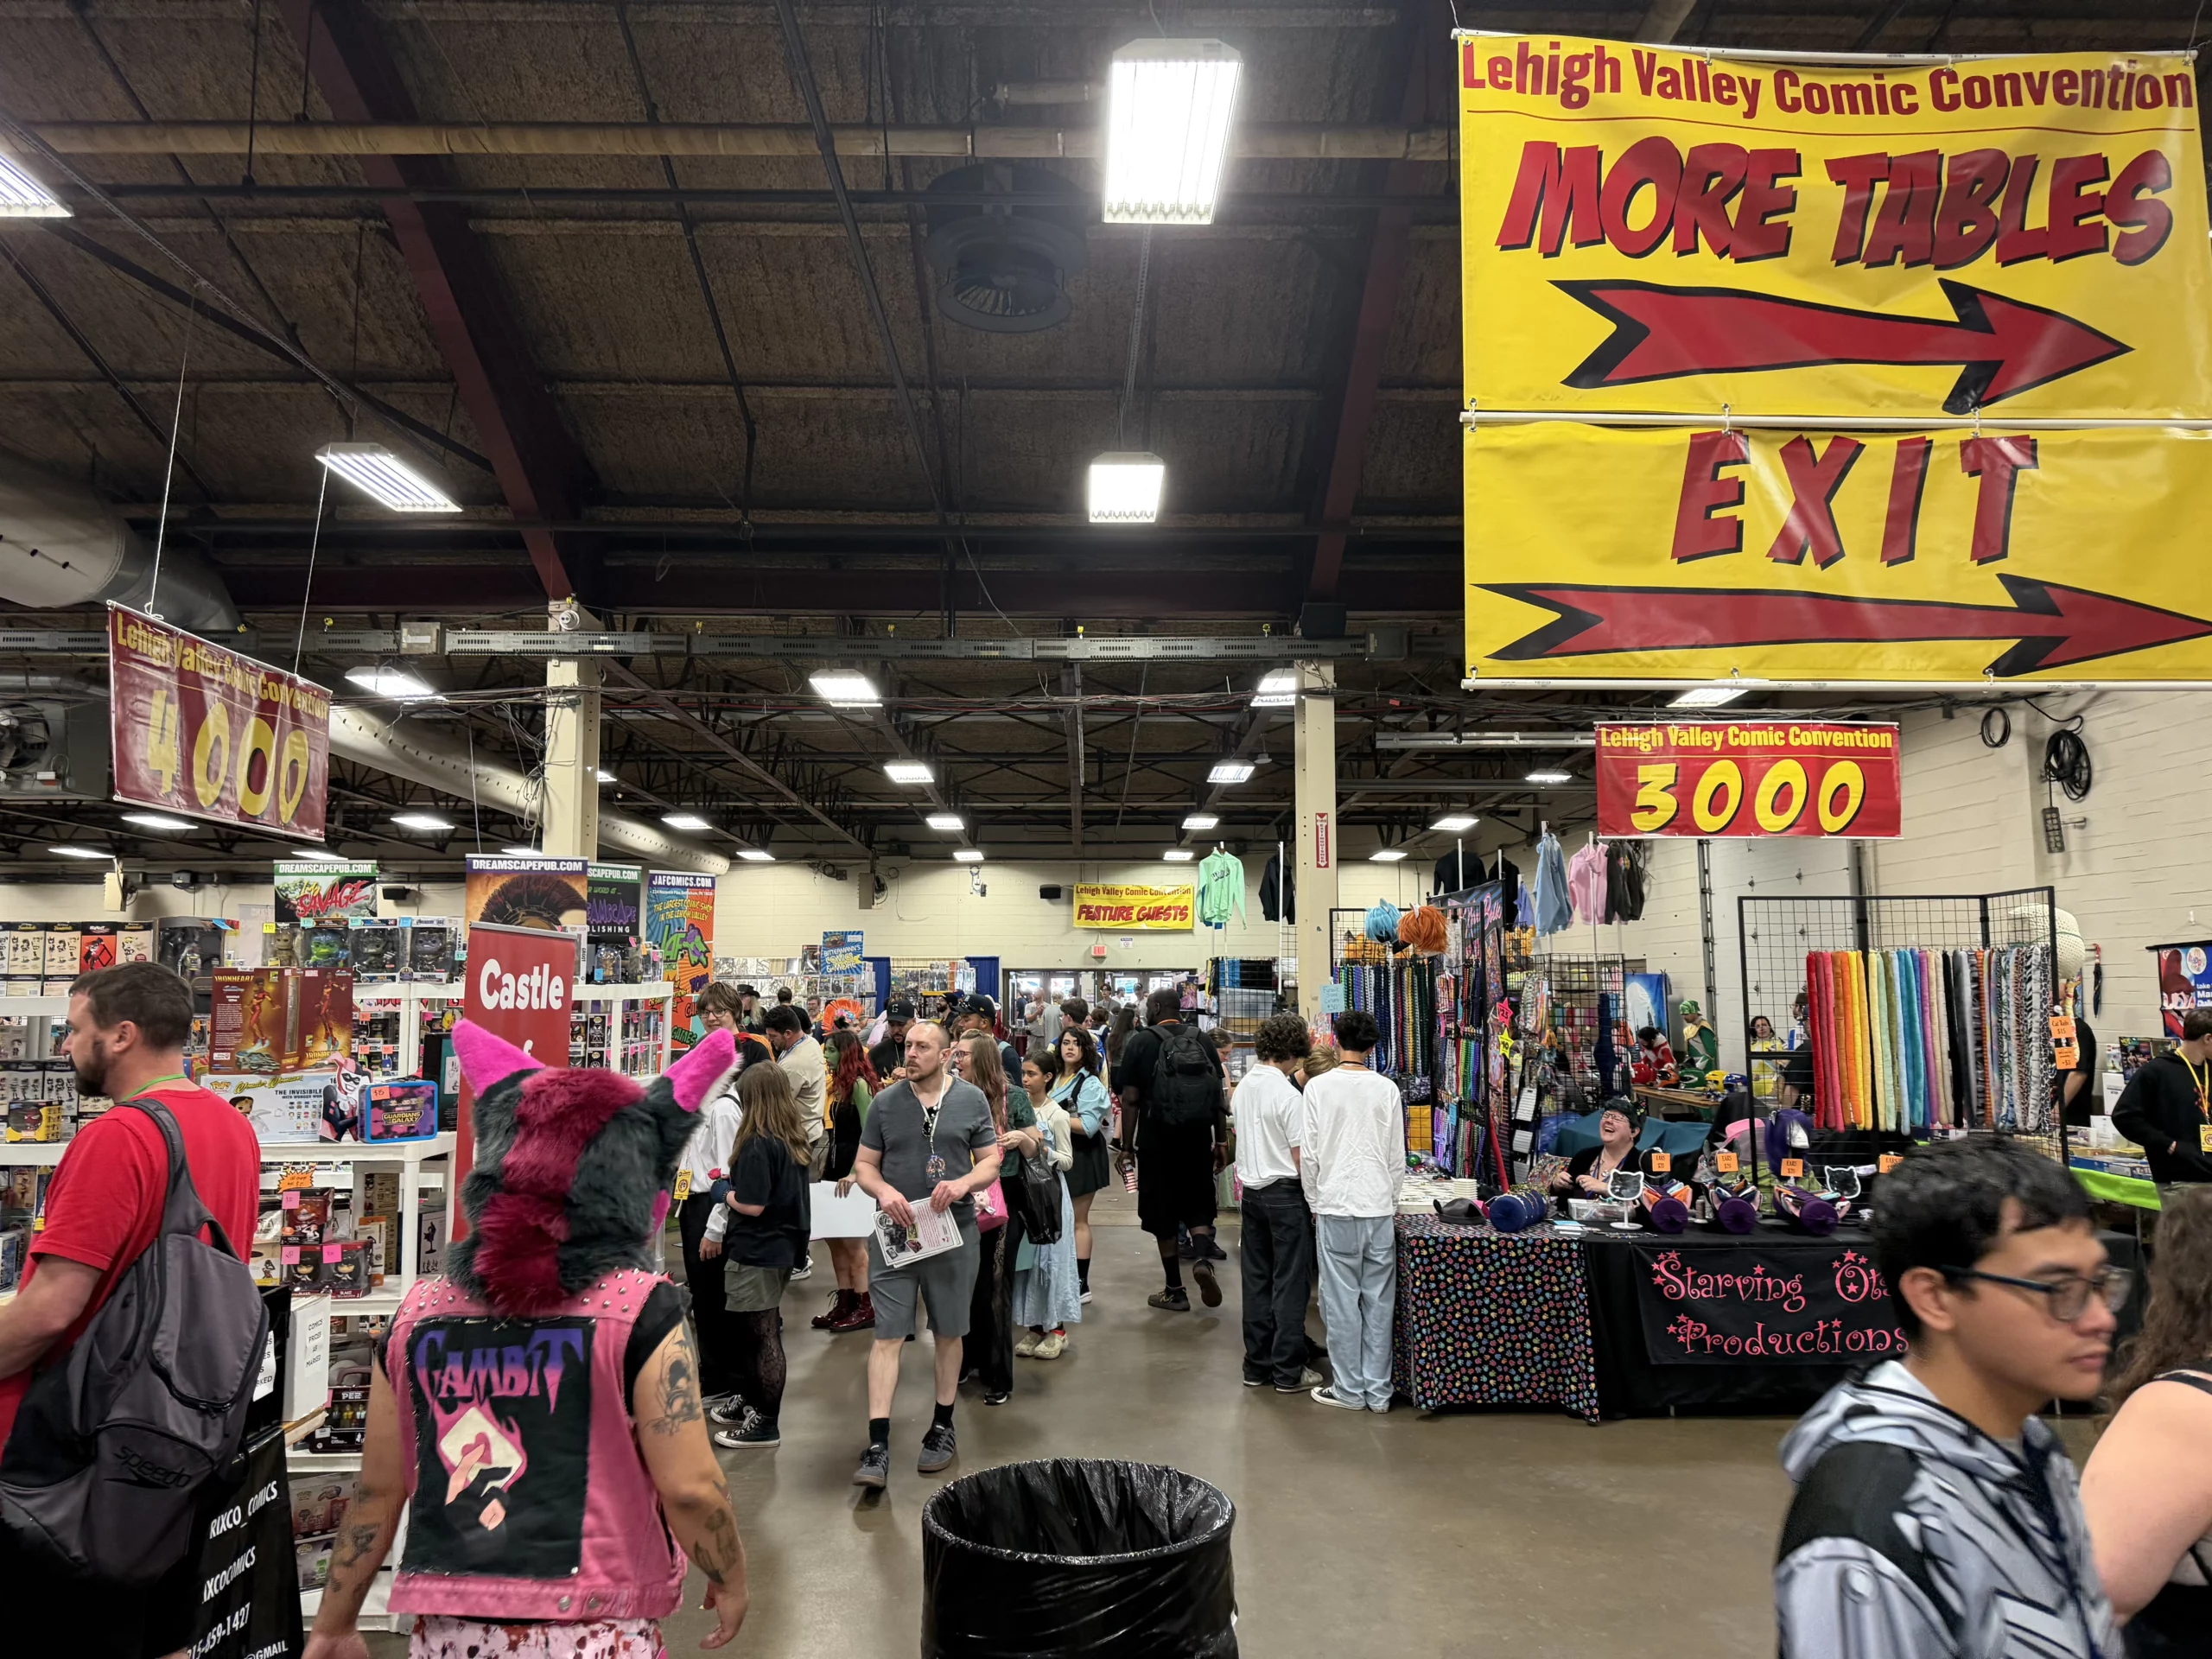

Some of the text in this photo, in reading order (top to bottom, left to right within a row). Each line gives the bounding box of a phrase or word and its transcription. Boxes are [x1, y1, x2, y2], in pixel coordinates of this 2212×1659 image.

[1464, 41, 2194, 119] Lehigh Valley Comic Convention
[1497, 136, 2174, 270] MORE TABLES
[1671, 429, 2039, 569] EXIT
[117, 611, 328, 720] Lehigh Valley Comic Convention
[1600, 725, 1893, 751] Lehigh Valley Comic Convention
[148, 690, 310, 824] 4000
[1630, 757, 1866, 836] 3000
[279, 864, 372, 873] DREAMSCAPEPUB.COM
[472, 859, 582, 872] DREAMSCAPEPUB.COM
[588, 868, 638, 880] SCAPEPUB.COM
[652, 875, 712, 887] JAFCOMICS.COM
[296, 880, 370, 918] SAVAGE
[1076, 886, 1101, 897] Lehigh
[1102, 887, 1123, 898] Valley
[1125, 887, 1148, 896] Comic
[653, 899, 713, 913] THE LARGEST COMIC SHOP
[1077, 904, 1188, 922] FEATURE GUESTS
[658, 913, 665, 923] IN
[665, 911, 674, 920] THE
[691, 911, 709, 922] VALLEY
[824, 944, 861, 957] BITTERMANN'S
[1093, 946, 1105, 955] EXIT
[825, 953, 854, 964] COMICS
[834, 960, 857, 971] MORE
[480, 958, 564, 1010] Castle
[2197, 990, 2212, 999] Ma
[671, 1026, 698, 1046] GAMES
[306, 1049, 343, 1059] IRONHEA
[373, 1089, 385, 1097] $15
[383, 1111, 421, 1120] GUARDIANS
[1658, 1258, 1891, 1313] Starving Ot
[308, 1319, 323, 1332] COMICS
[1675, 1319, 1910, 1357] Productions
[312, 1344, 318, 1353] AS
[306, 1354, 321, 1368] MARKED
[415, 1328, 584, 1420] GAMBIT
[341, 1391, 363, 1401] PEZ
[113, 1444, 193, 1489] speedo
[201, 1545, 256, 1605] IXCOCOMICS
